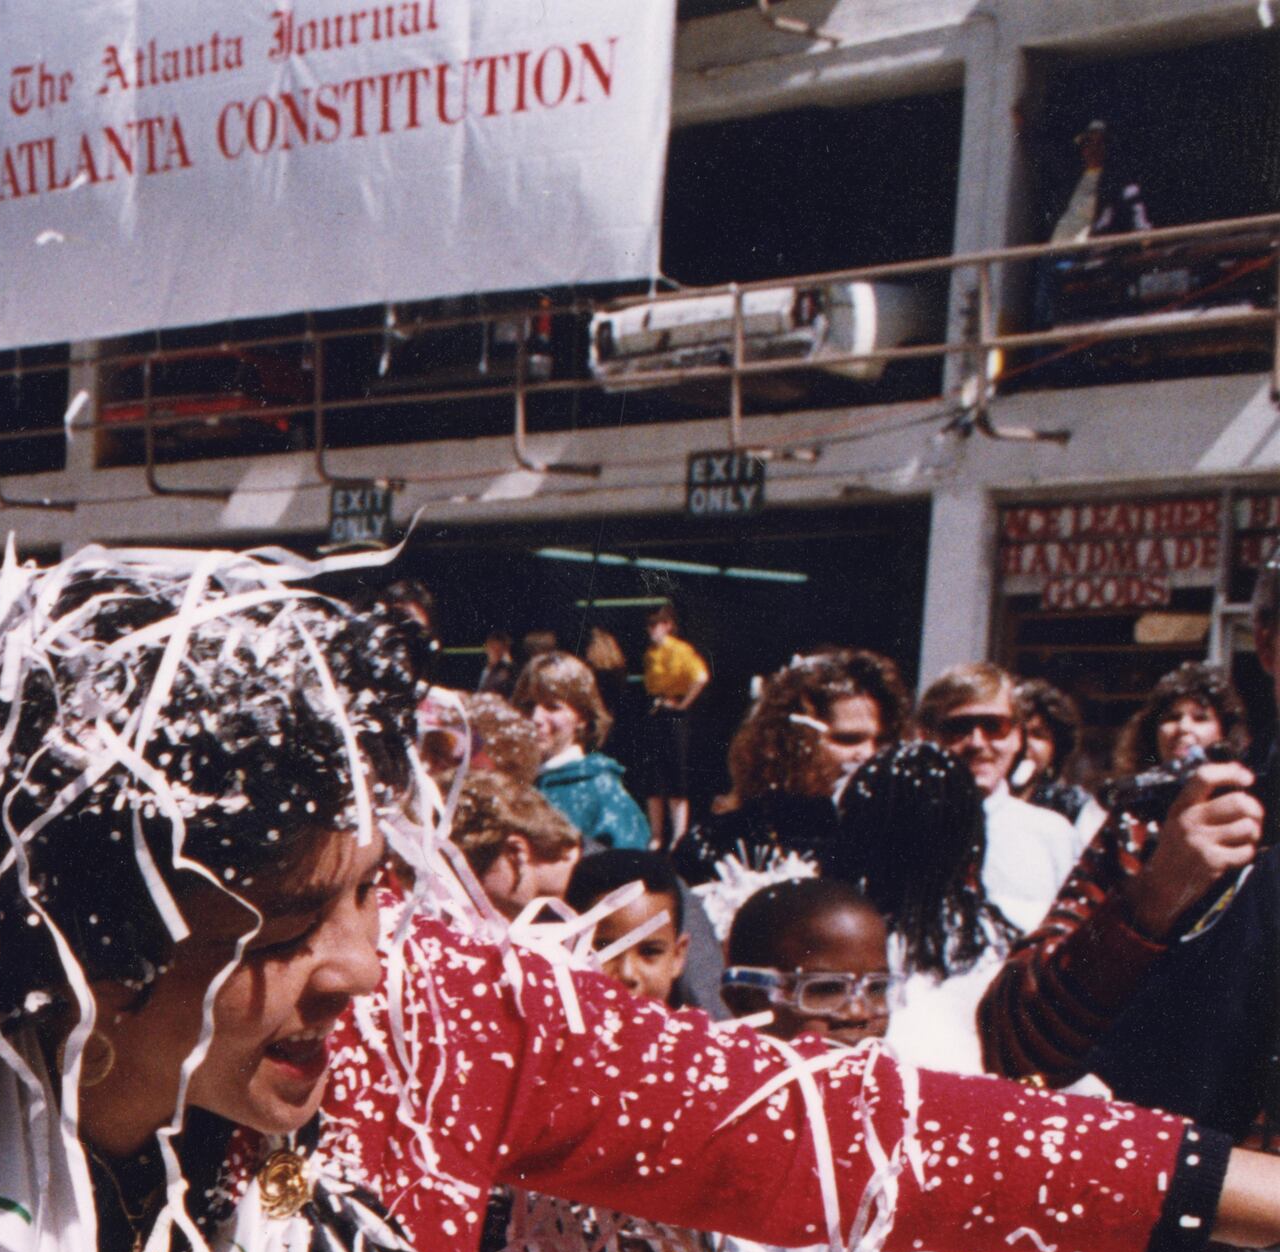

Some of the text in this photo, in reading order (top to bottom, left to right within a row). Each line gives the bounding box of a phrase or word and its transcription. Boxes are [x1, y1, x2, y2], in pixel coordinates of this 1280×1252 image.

[8, 0, 439, 117] The Atlanta Journal
[215, 36, 620, 160] CONSTITUTION
[691, 454, 759, 483] EXIT
[690, 484, 758, 514] ONLY
[1003, 536, 1218, 576] HANDMADE
[1042, 575, 1171, 610] GOODS
